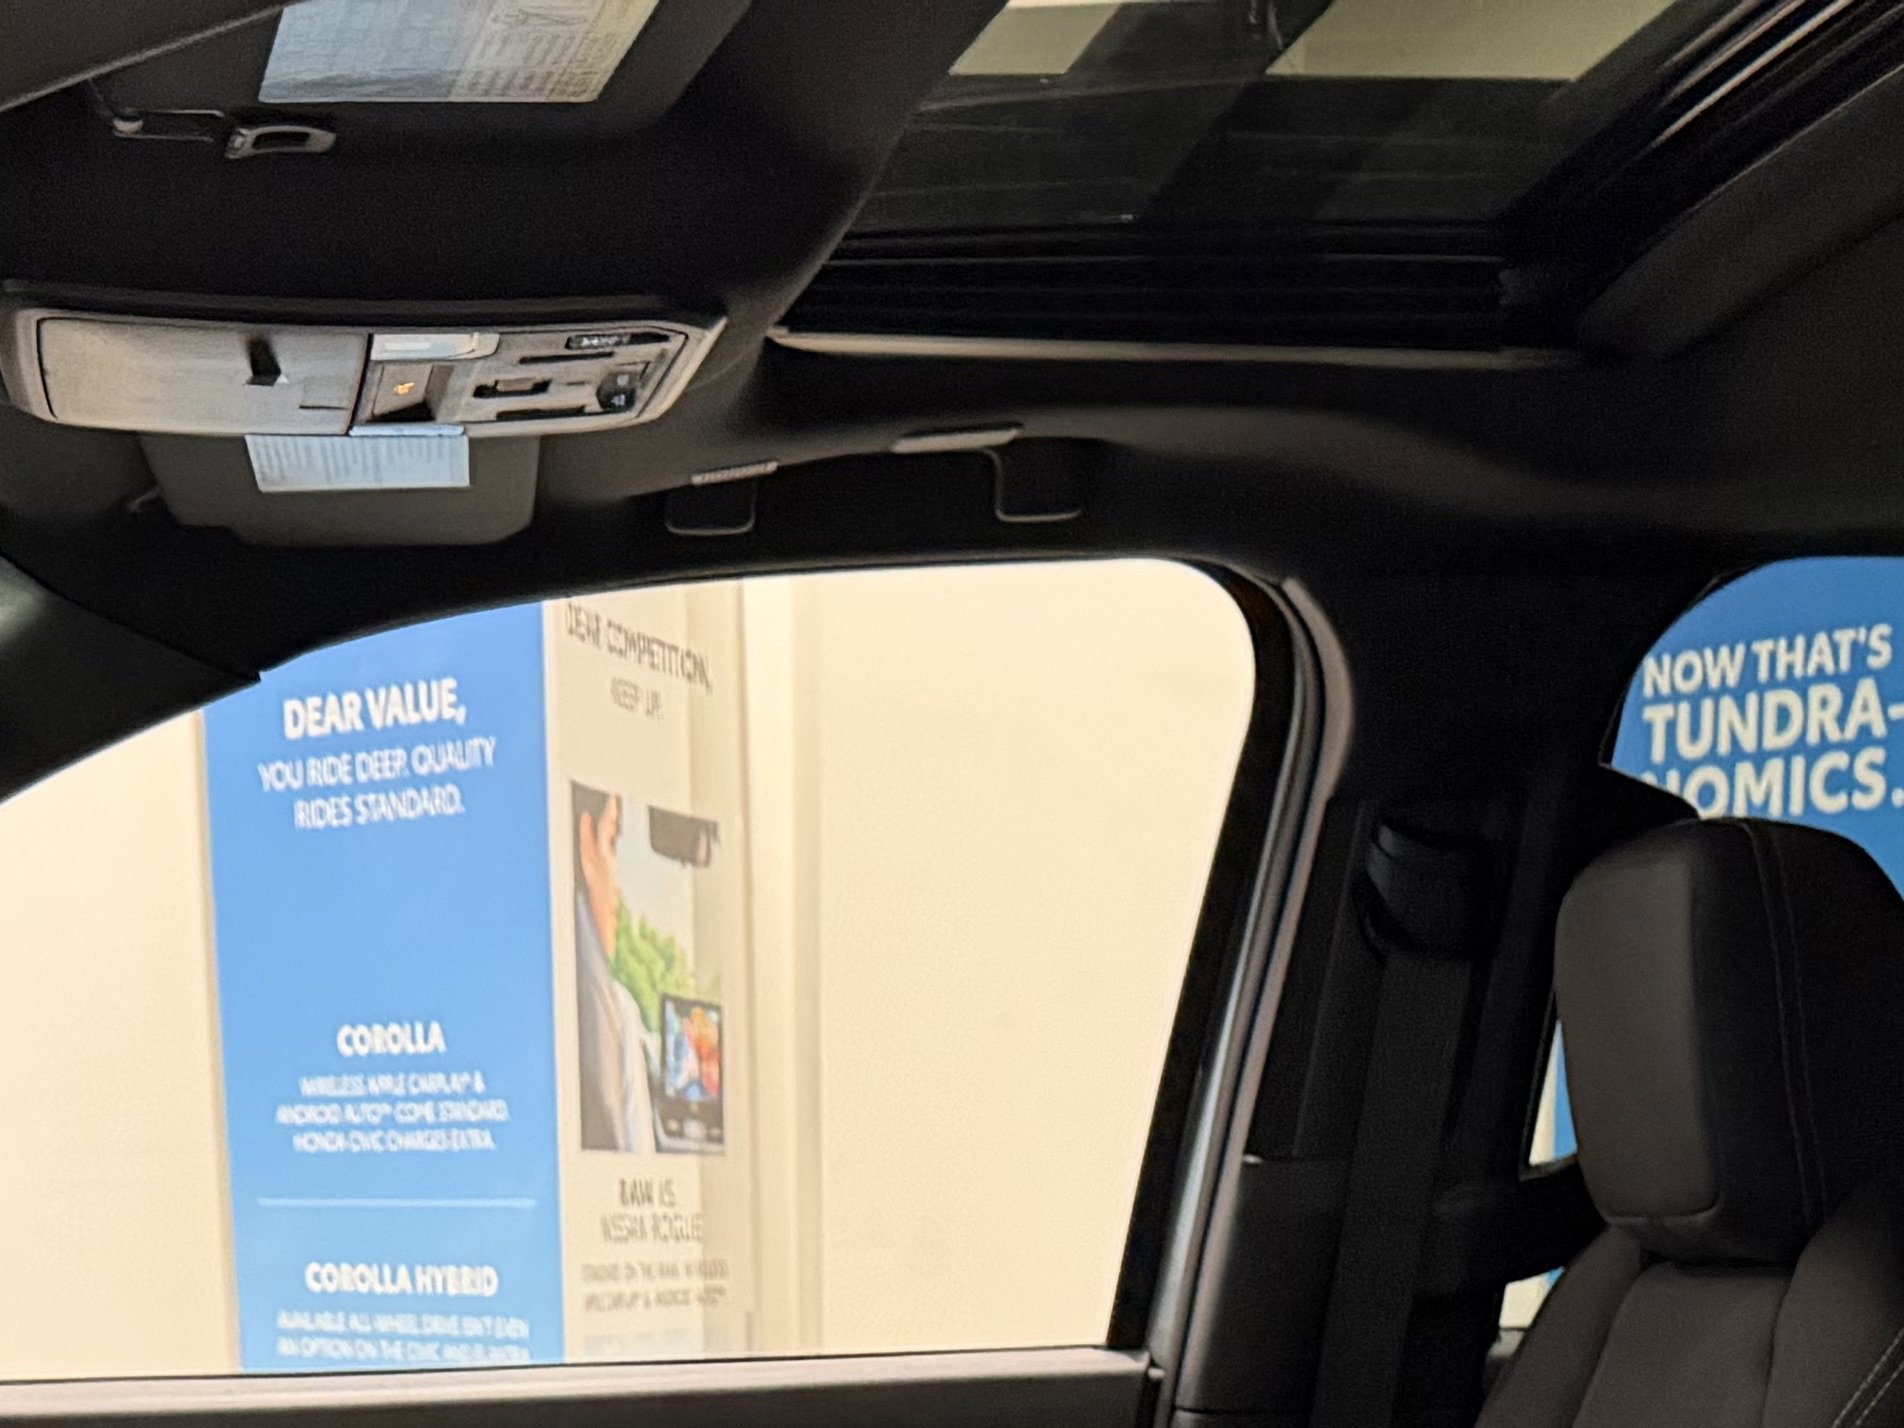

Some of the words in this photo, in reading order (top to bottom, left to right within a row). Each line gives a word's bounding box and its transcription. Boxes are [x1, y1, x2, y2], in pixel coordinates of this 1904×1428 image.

[1642, 642, 1745, 698] NOW
[1751, 623, 1894, 684] THAT'S
[283, 690, 364, 741] DEAR
[364, 677, 467, 727] VALUE,
[257, 761, 304, 791] YOU
[306, 752, 353, 787] RIDE
[411, 735, 495, 776] QUALITY
[294, 792, 353, 830] RIDES
[355, 782, 466, 825] STANDARD.
[337, 1020, 447, 1057] COROLLA
[305, 1261, 413, 1295] COROLLA
[415, 1263, 499, 1297] HYBRID
